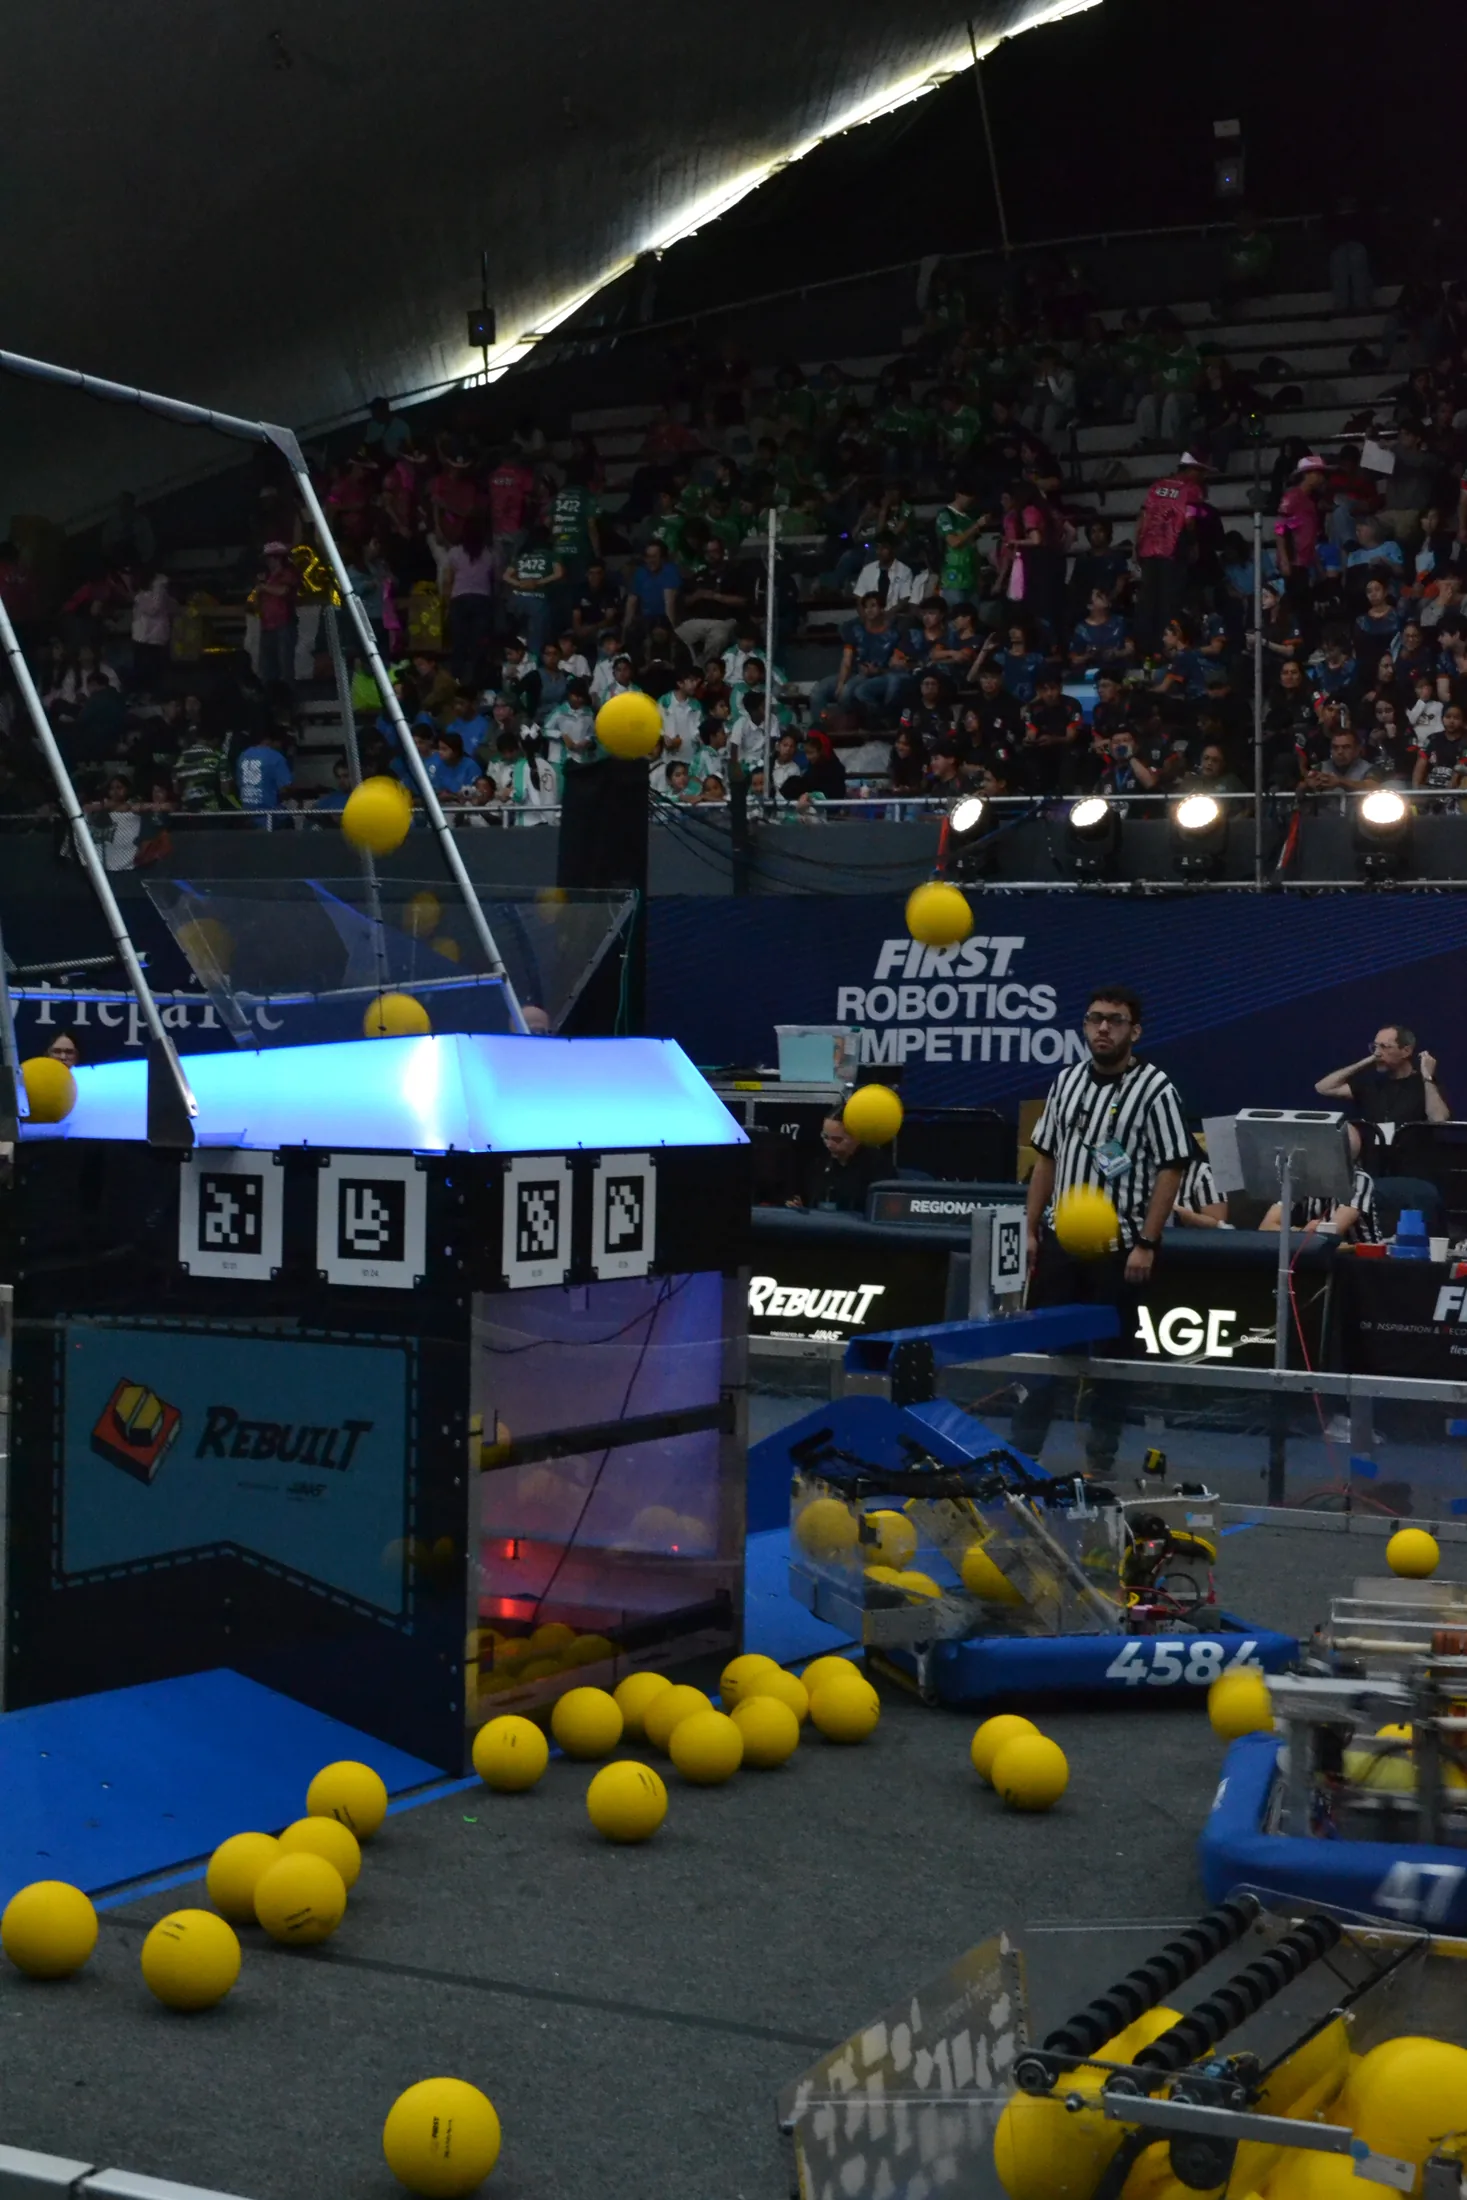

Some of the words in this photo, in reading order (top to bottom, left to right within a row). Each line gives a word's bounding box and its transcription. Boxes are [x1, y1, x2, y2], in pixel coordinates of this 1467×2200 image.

[517, 559, 547, 571] 3472
[873, 936, 1026, 980] FIRST
[836, 983, 1058, 1022] ROBOTICS
[860, 1026, 1094, 1065] MPETITION
[748, 1275, 887, 1325] REBUILT
[195, 1405, 375, 1472] REBUILT
[1105, 1640, 1265, 1686] 4584
[1372, 1860, 1467, 1923] 47
